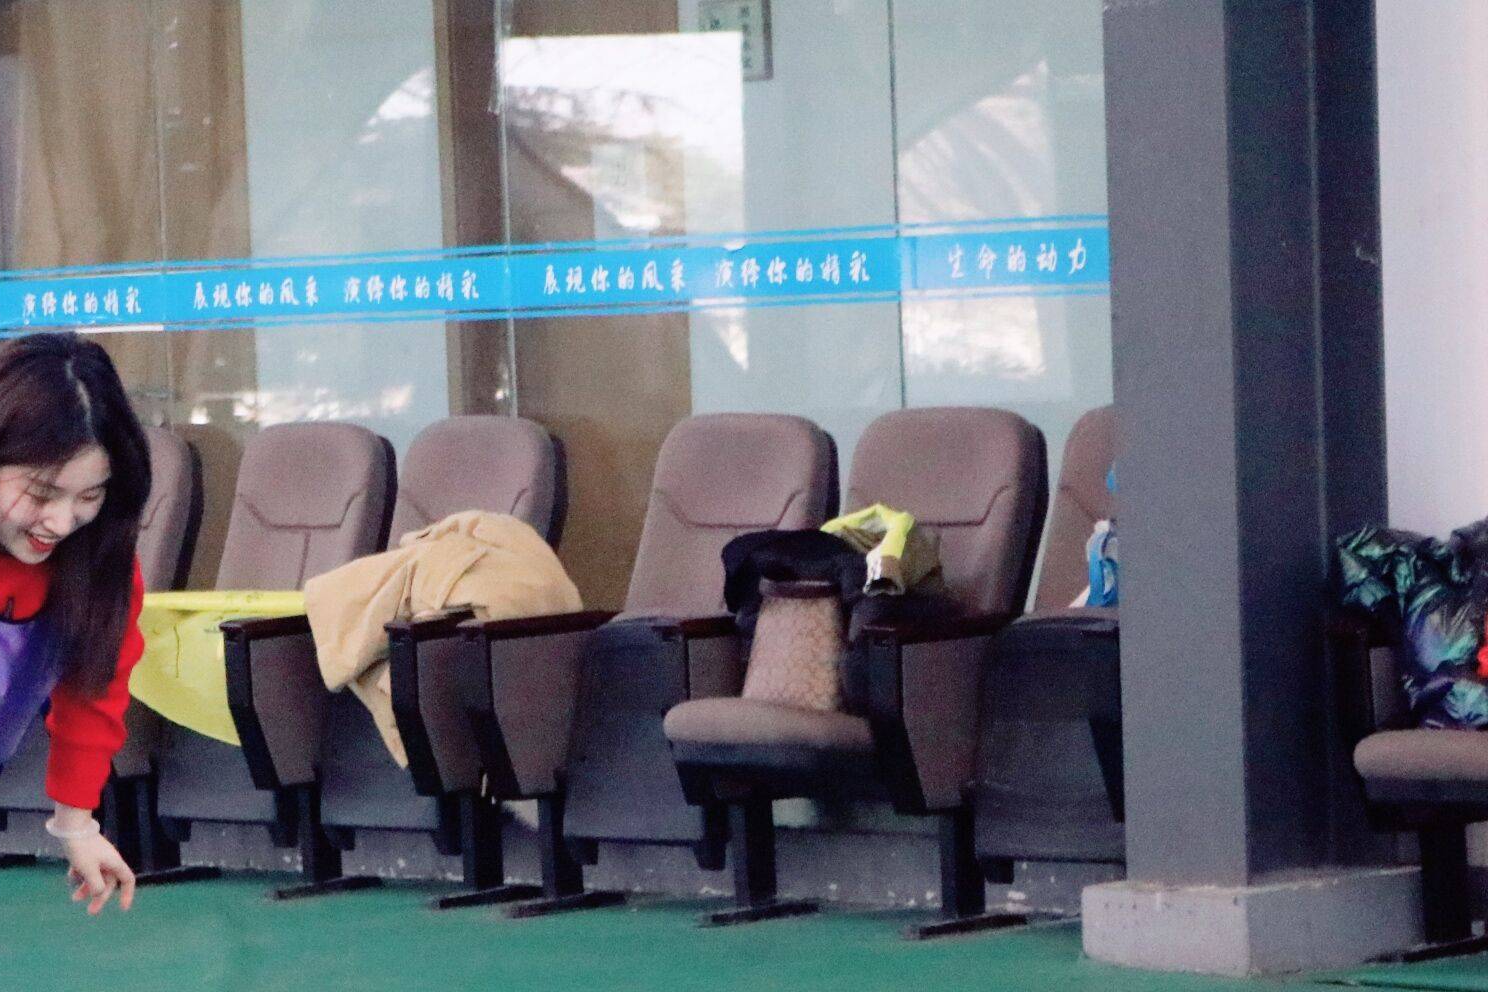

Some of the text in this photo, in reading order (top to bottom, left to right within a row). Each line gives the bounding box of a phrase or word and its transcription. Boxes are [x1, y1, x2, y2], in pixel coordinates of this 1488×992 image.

[543, 250, 871, 295] 展现你的风采 演绎你的精彩
[948, 238, 1087, 279] 生命的动力
[193, 275, 319, 310] 展现你的风采
